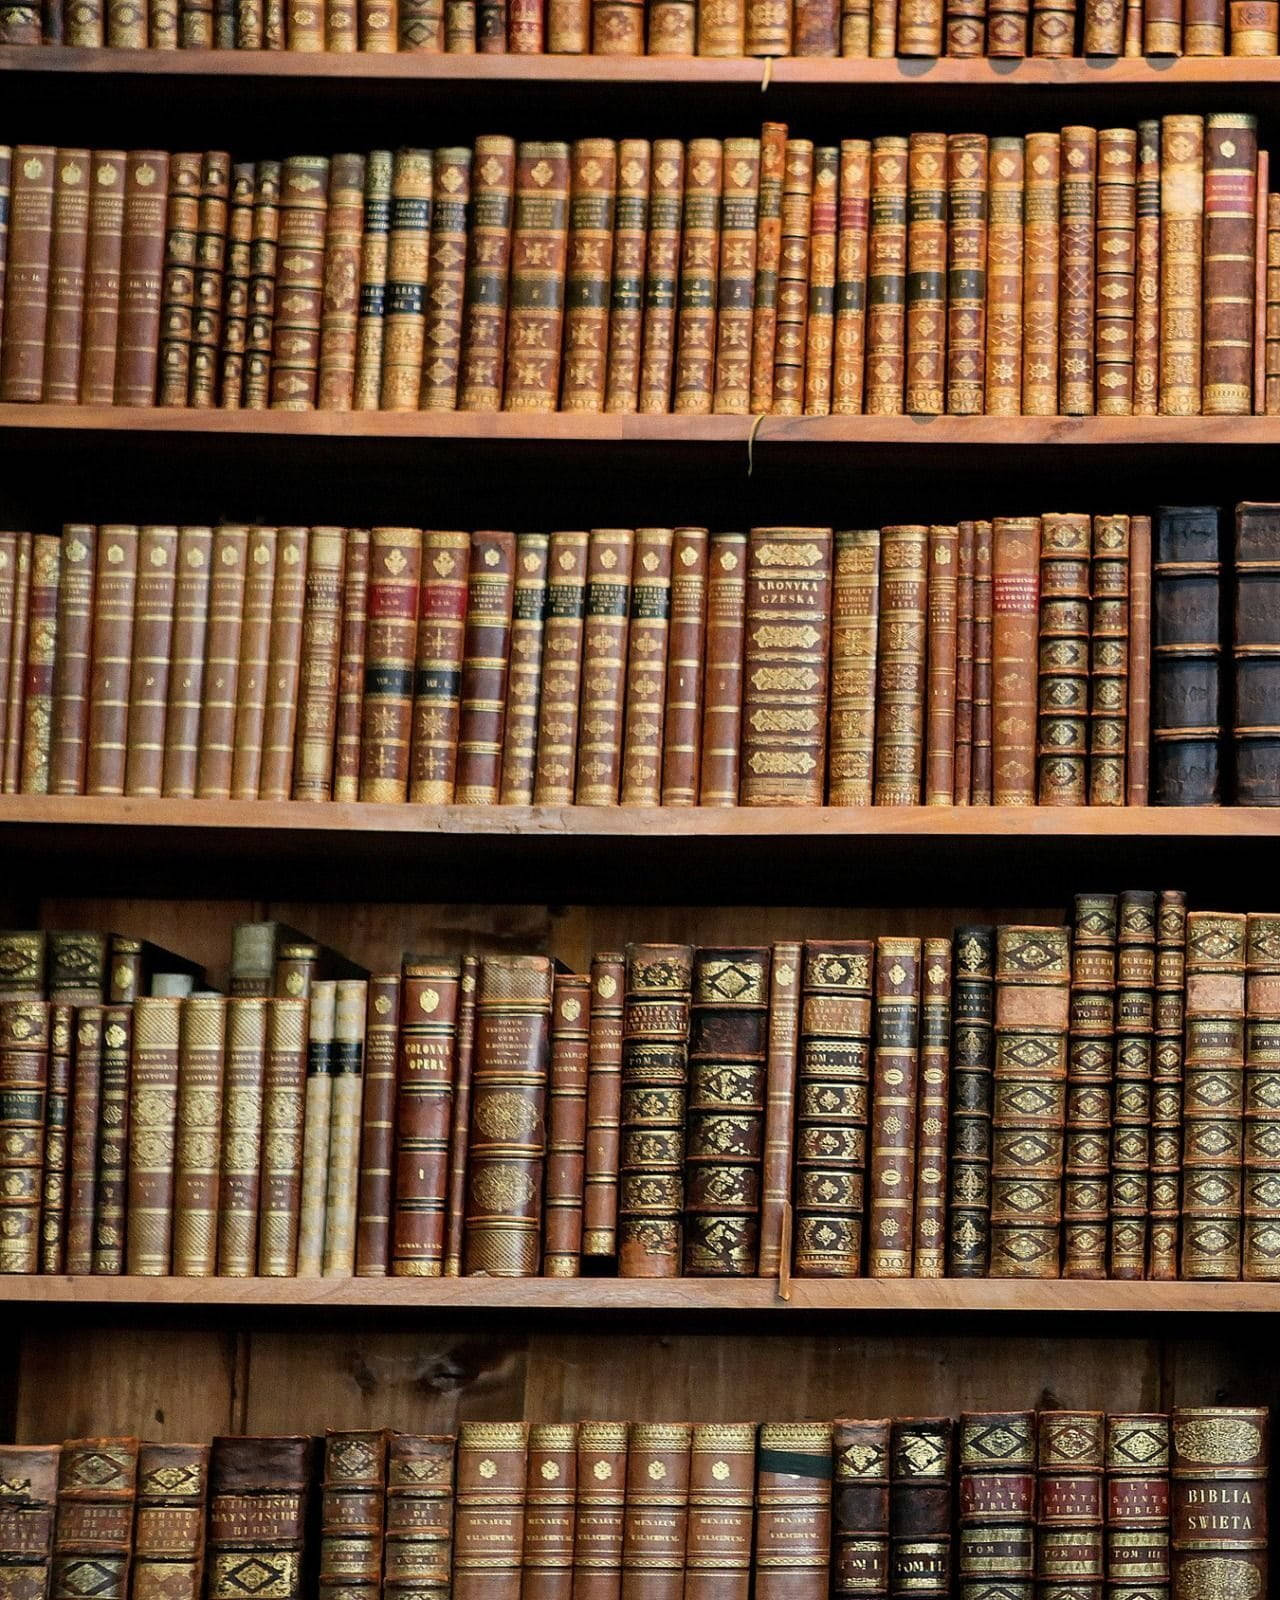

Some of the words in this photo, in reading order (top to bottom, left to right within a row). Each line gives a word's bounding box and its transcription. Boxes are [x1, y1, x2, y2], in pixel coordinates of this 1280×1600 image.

[1188, 1489, 1252, 1504] BIBLIA
[969, 1502, 1018, 1511] BIBLE
[1116, 1506, 1161, 1514] BIBLE
[967, 1546, 994, 1554] TOM
[1114, 1551, 1138, 1559] TOM
